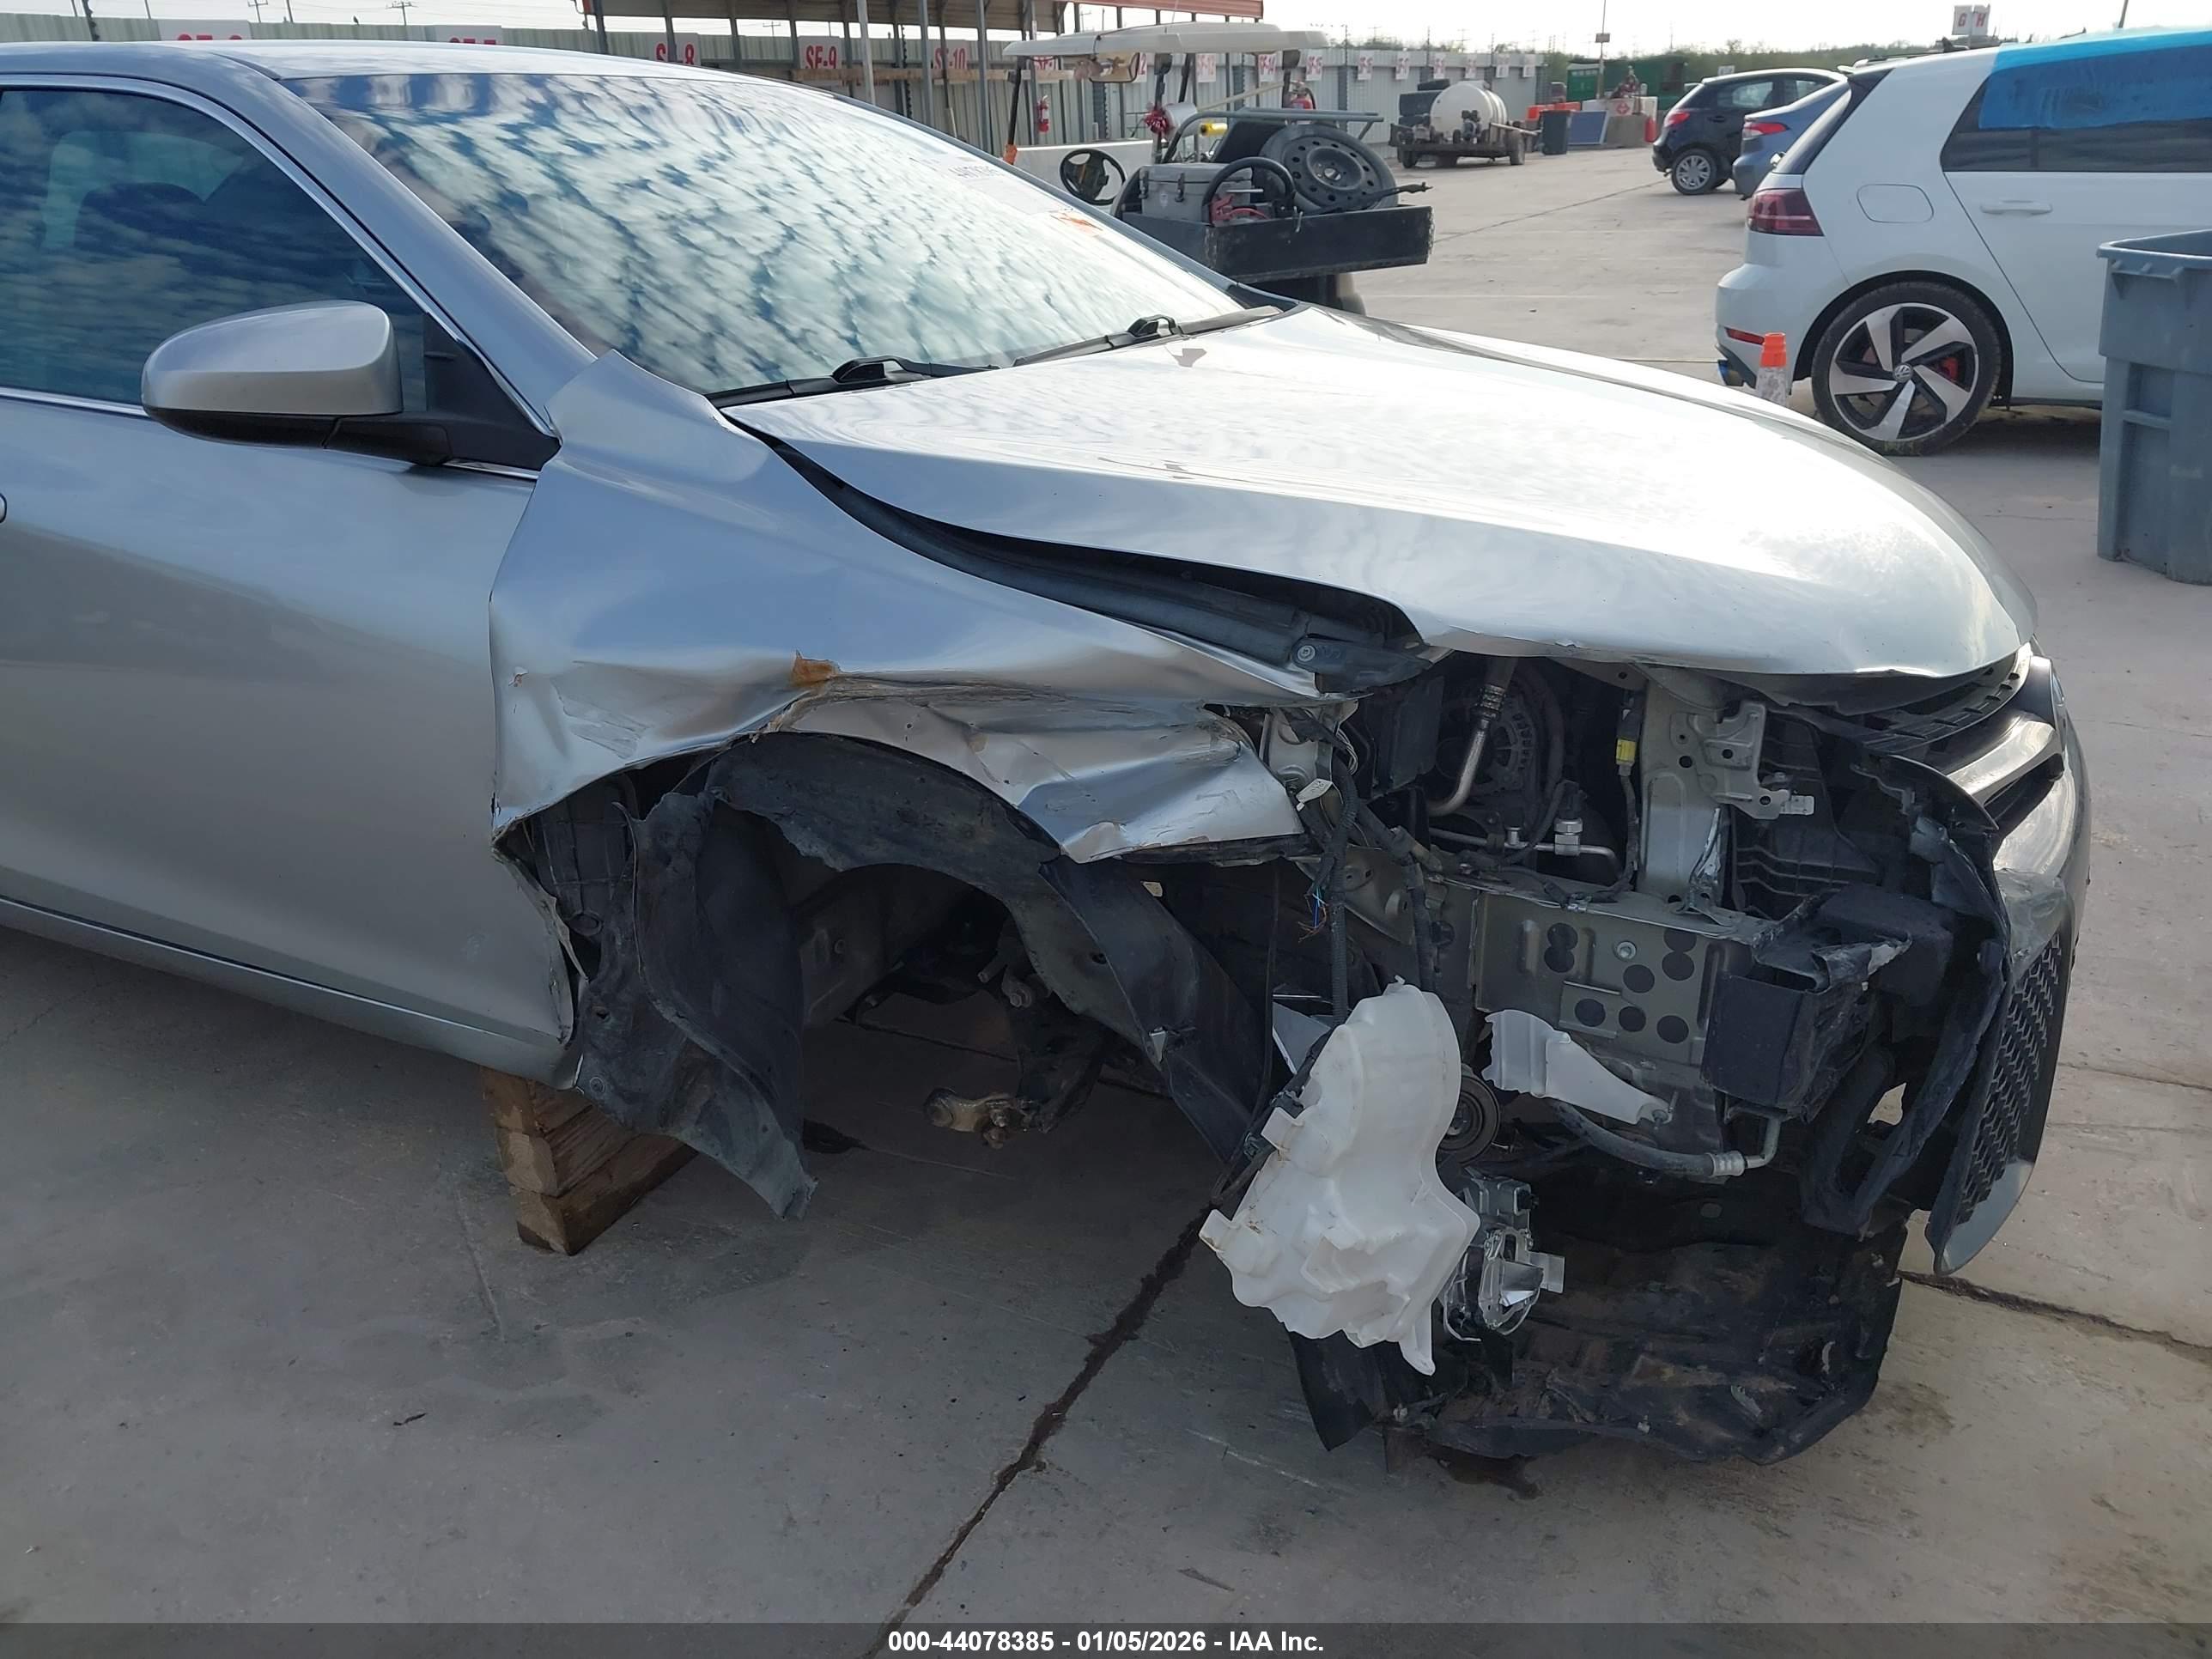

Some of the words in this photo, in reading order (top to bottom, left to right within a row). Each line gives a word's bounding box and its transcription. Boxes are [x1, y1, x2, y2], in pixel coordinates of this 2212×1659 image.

[1958, 13, 1967, 27] G
[1976, 13, 1986, 27] H
[656, 43, 695, 64] S-8
[805, 45, 837, 69] SF-9
